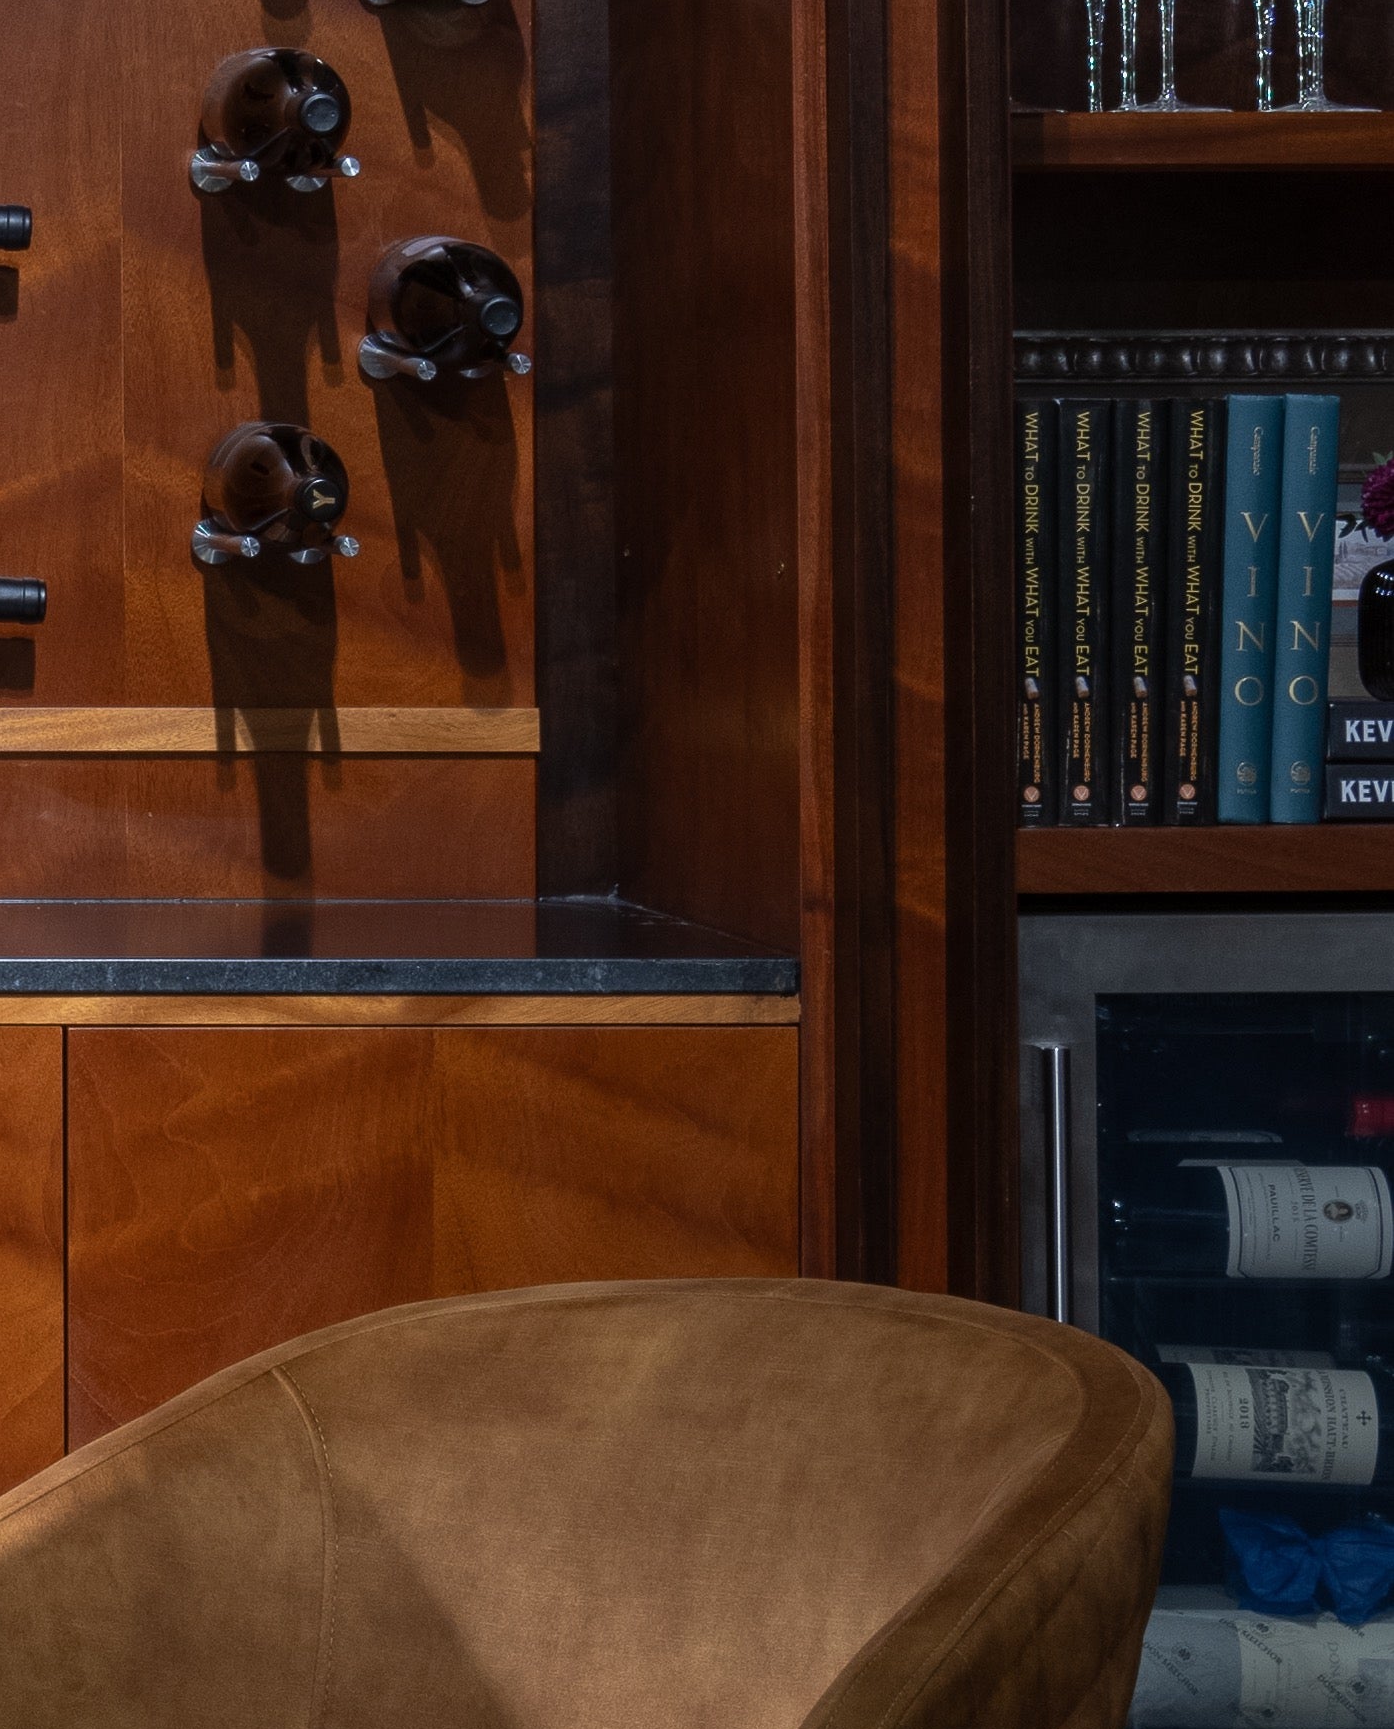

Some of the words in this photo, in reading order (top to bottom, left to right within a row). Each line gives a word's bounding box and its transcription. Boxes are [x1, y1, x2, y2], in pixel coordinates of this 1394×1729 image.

[1024, 412, 1040, 462] WHAT
[1076, 411, 1091, 461] WHAT
[1136, 411, 1151, 462] WHAT
[1188, 410, 1205, 461] WHAT
[1025, 466, 1035, 481] TO
[1076, 465, 1086, 480] TO
[1136, 465, 1146, 481] TO
[1188, 464, 1199, 479] TO
[1024, 484, 1040, 534] DRINK
[1076, 483, 1091, 533] DRINK
[1135, 484, 1150, 533] DRINK
[1187, 482, 1203, 532] DRINK
[1025, 538, 1035, 566] WITH
[1076, 537, 1085, 565] WITH
[1135, 537, 1145, 565] WITH
[1186, 536, 1197, 563] WITH
[1024, 568, 1040, 618] WHAT
[1076, 567, 1090, 617] WHAT
[1135, 567, 1149, 618] WHAT
[1185, 565, 1201, 616] WHAT
[1234, 511, 1269, 707] VINO
[1288, 510, 1325, 706] VINO
[1025, 620, 1035, 643] YOU
[1076, 618, 1085, 642] YOU
[1134, 619, 1144, 642] YOU
[1184, 617, 1195, 641] YOU
[1024, 646, 1040, 678] EAT
[1075, 645, 1090, 677] EAT
[1134, 645, 1148, 677] EAT
[1184, 644, 1199, 676] EAT
[1268, 1183, 1282, 1243] PAUILLAC
[1301, 1223, 1320, 1271] COMTESS
